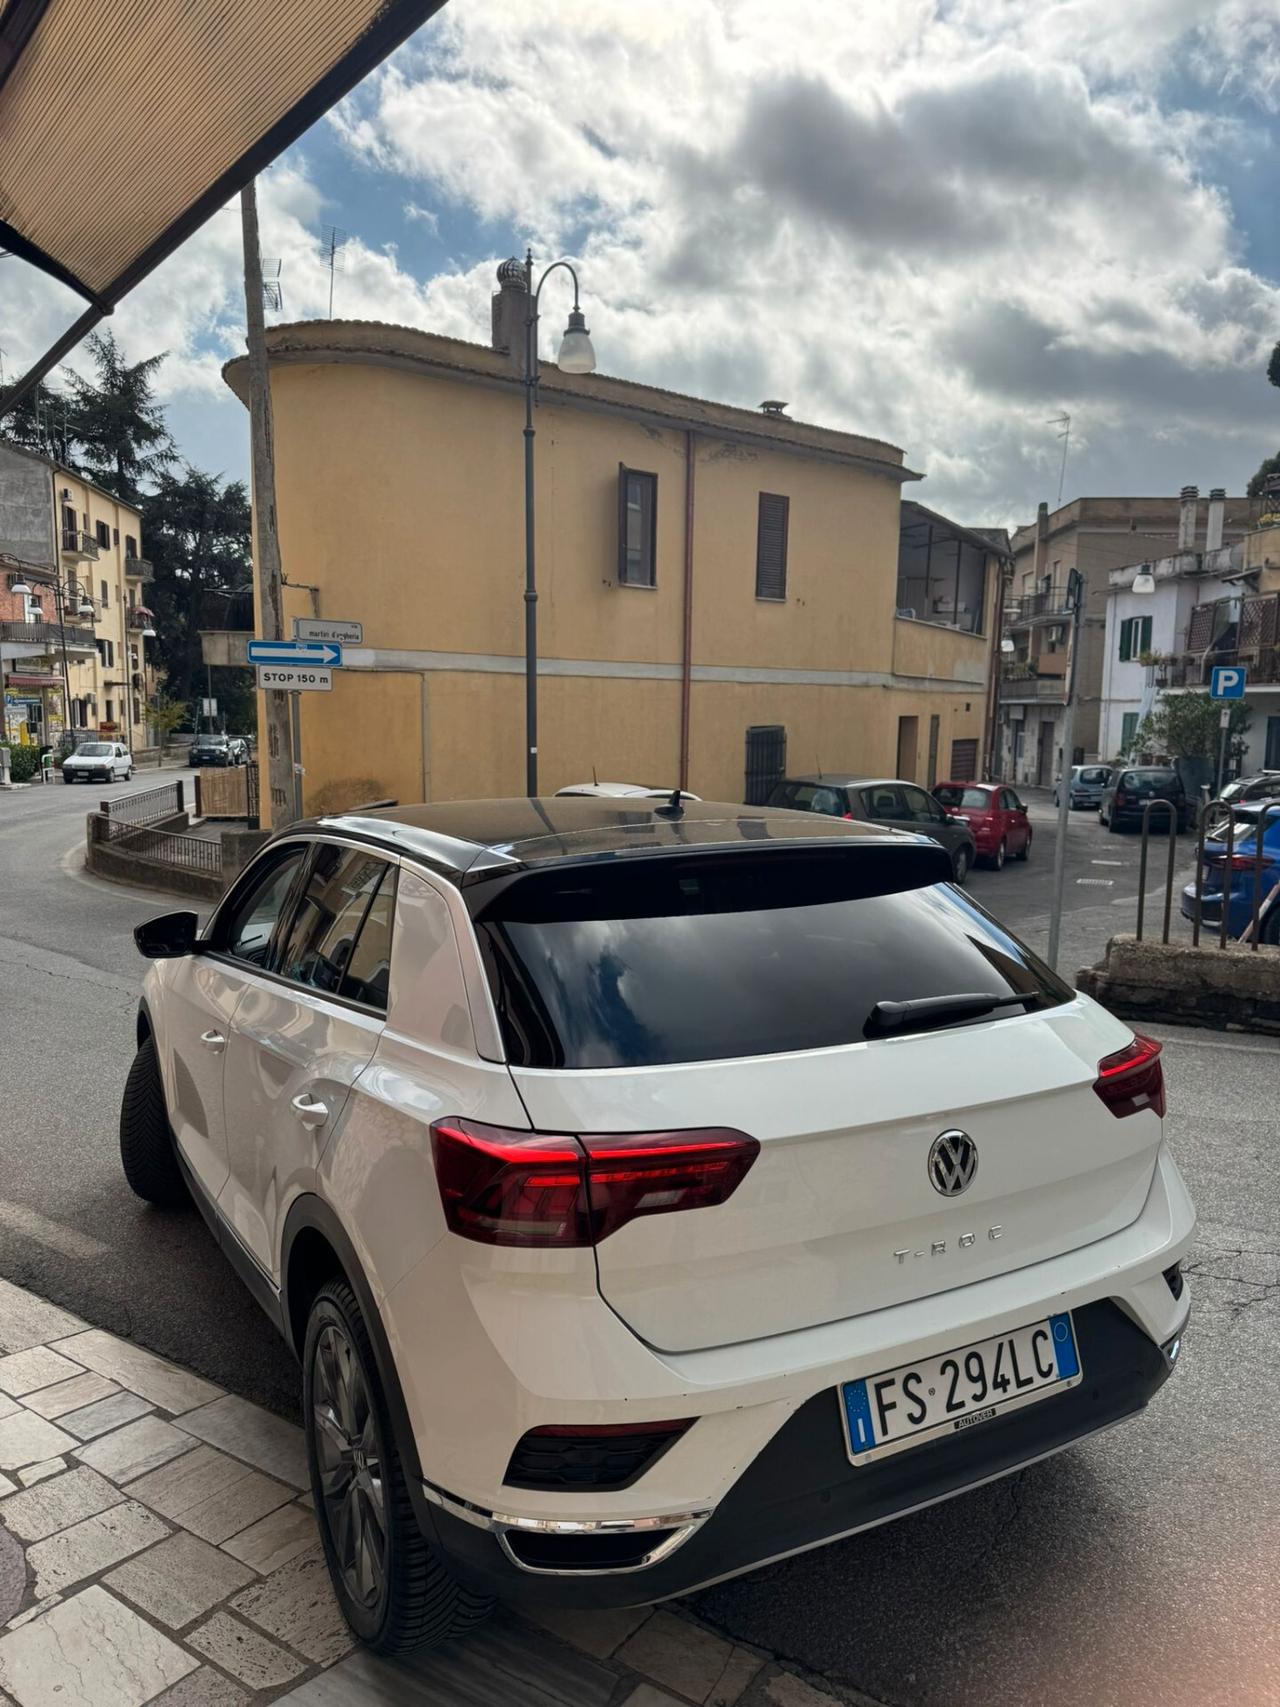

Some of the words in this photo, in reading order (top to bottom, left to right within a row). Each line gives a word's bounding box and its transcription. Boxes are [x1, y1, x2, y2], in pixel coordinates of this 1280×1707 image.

[264, 673, 294, 682] STOP
[297, 674, 315, 683] 150
[1217, 670, 1239, 695] P
[893, 1225, 1002, 1264] T-ROC
